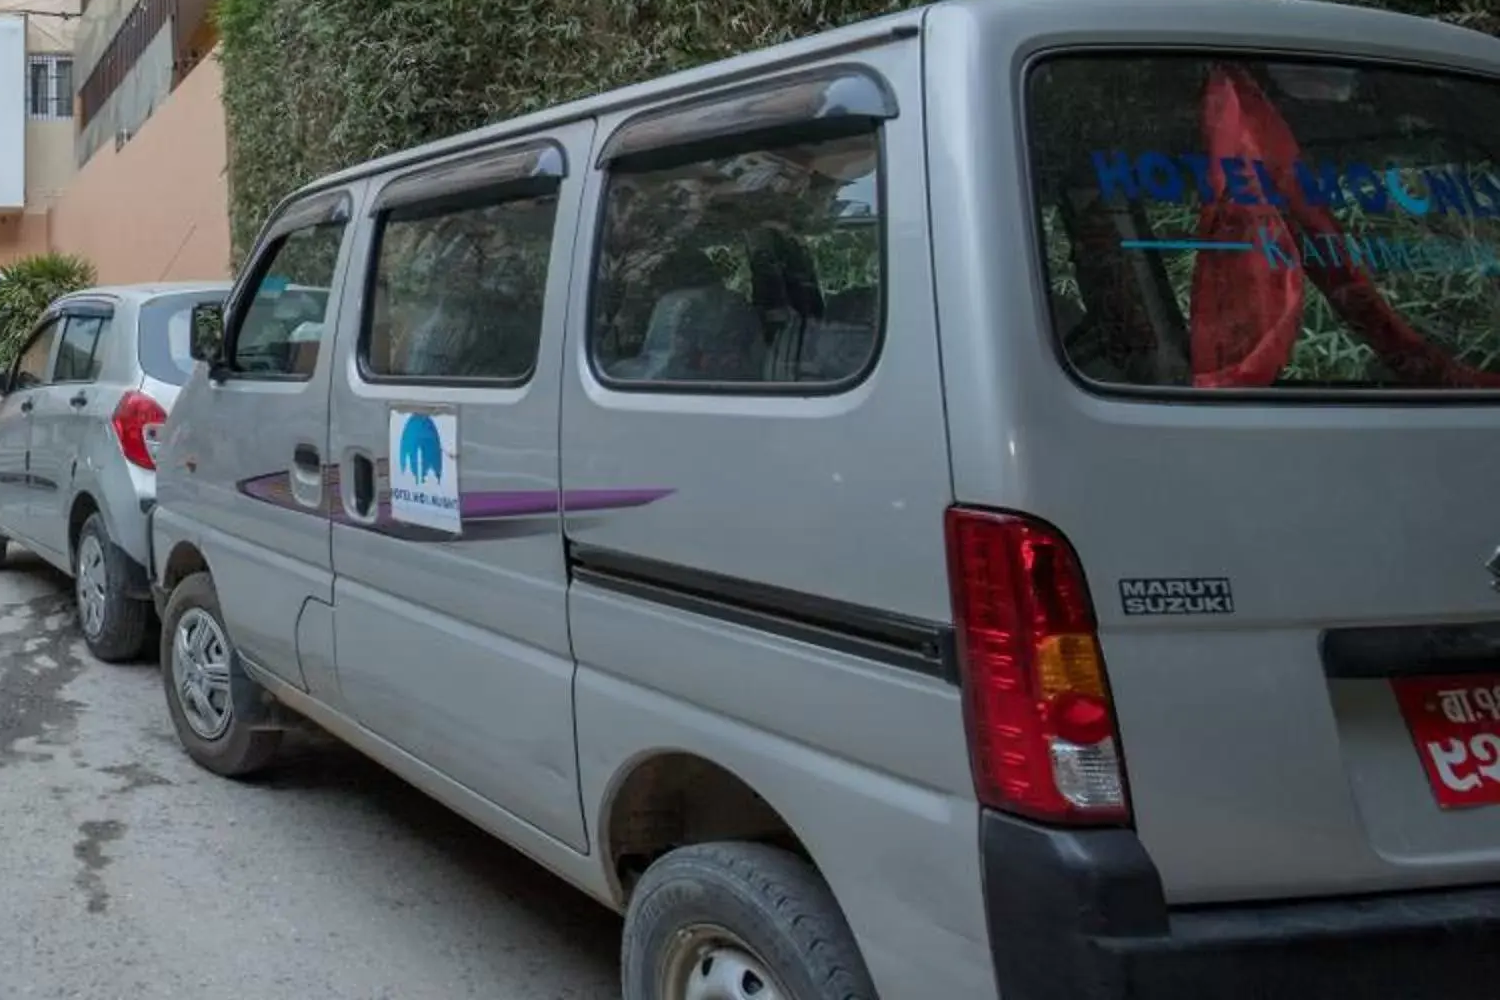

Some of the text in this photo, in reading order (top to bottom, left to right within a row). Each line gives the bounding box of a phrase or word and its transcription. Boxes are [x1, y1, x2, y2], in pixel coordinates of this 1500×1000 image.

[1093, 151, 1287, 207] HOTEL
[1121, 580, 1230, 596] MARUTI
[1124, 597, 1234, 613] SUZUKI
